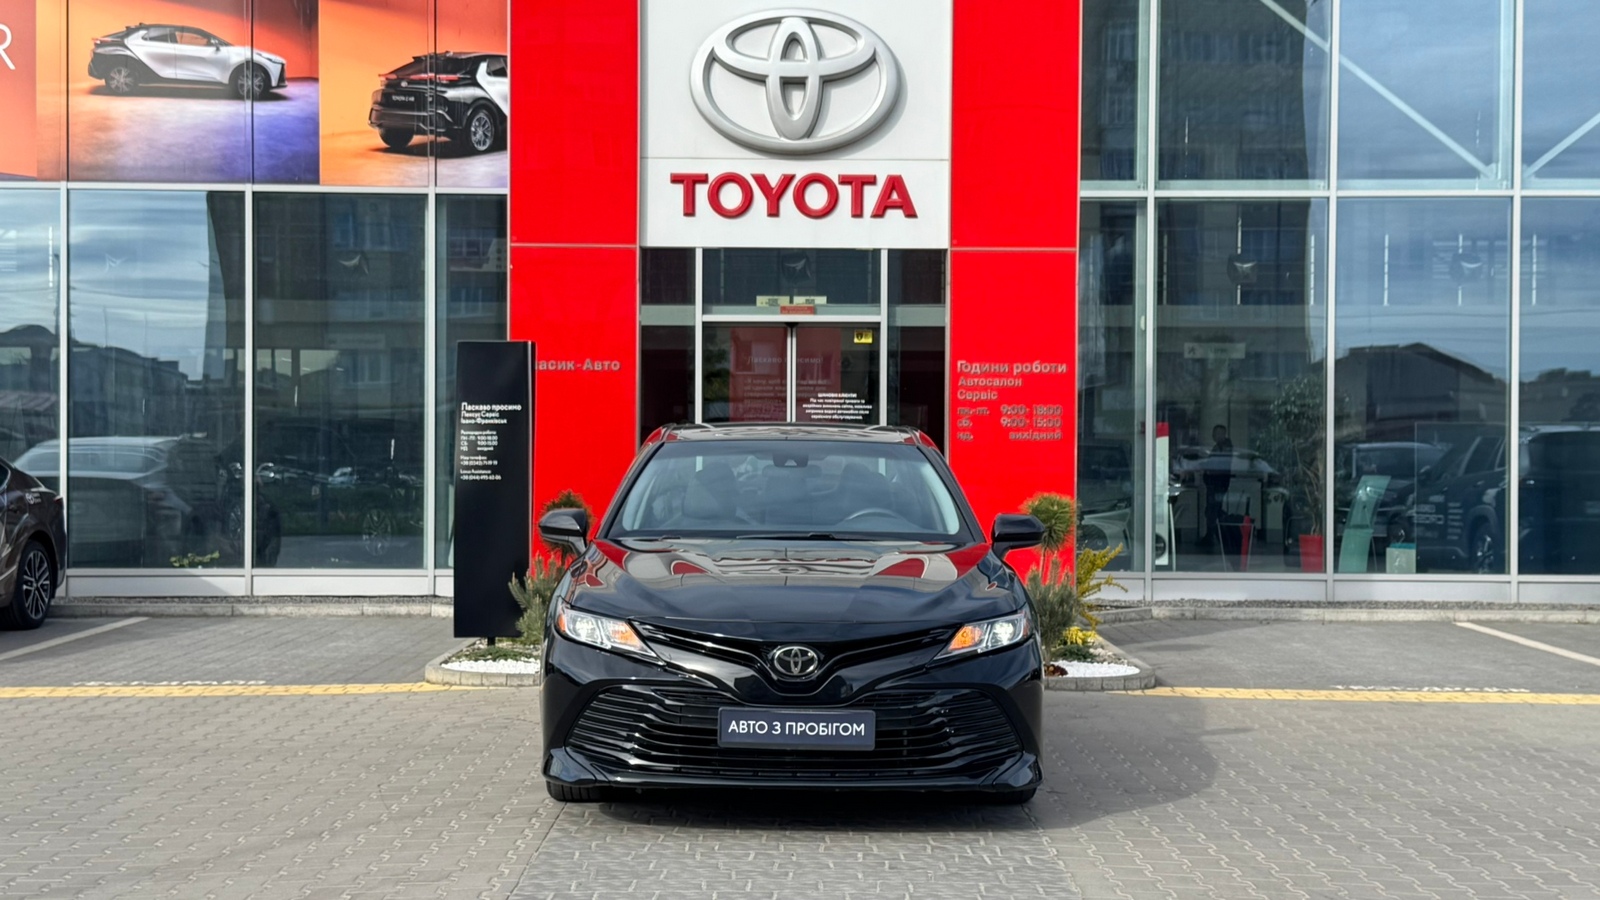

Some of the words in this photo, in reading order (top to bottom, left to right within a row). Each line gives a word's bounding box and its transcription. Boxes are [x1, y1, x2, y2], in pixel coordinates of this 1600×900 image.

[670, 172, 918, 219] TOYOTA
[957, 360, 1009, 374] Години
[1013, 360, 1067, 375] роботи
[958, 377, 1022, 387] Автосалон
[957, 389, 998, 402] Сервіс
[491, 404, 522, 412] просимо
[1009, 430, 1062, 441] вихідний
[728, 720, 768, 734] АВТО
[771, 721, 781, 735] З
[785, 722, 865, 736] ПРОБІГОМ
